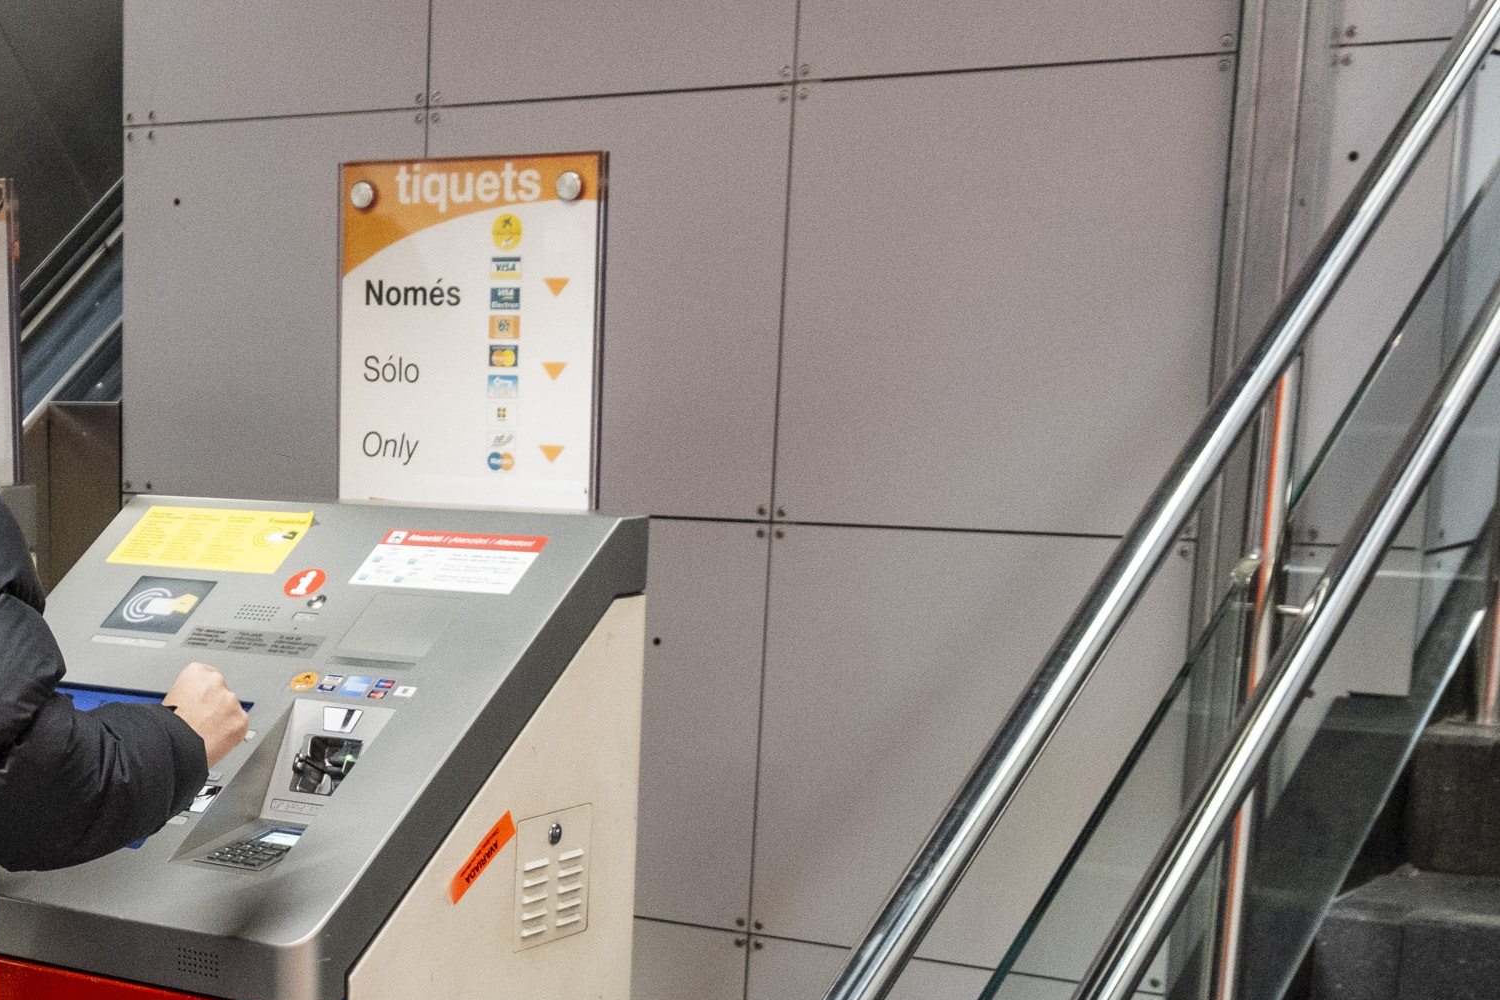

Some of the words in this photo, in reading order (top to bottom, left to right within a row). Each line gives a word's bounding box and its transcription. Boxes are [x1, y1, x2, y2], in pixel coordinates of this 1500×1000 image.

[396, 161, 542, 213] tiquets
[496, 263, 516, 271] VISA
[365, 279, 461, 306] Només
[363, 355, 420, 383] Sólo
[362, 431, 419, 465] Only
